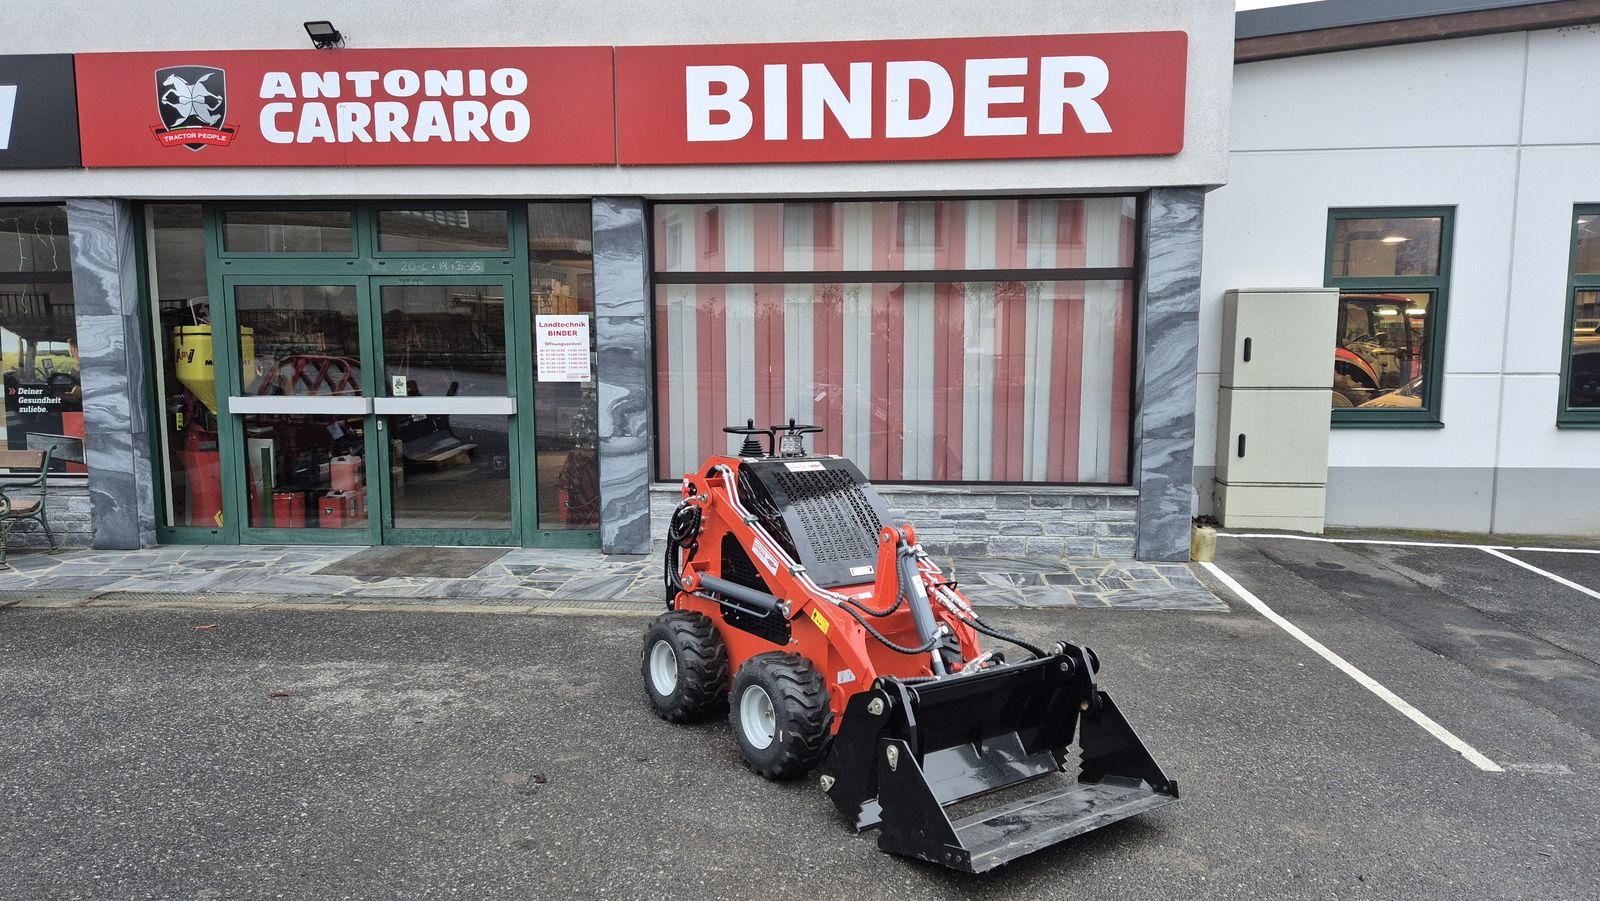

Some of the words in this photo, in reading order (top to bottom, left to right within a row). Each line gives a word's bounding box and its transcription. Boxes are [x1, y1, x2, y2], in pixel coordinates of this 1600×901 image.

[259, 68, 528, 98] ANTONIO
[686, 56, 1113, 141] BINDER
[259, 99, 531, 144] CARRARO
[163, 133, 197, 142] TRACTOR
[198, 133, 227, 142] PEOPLE
[17, 387, 44, 395] Deiner
[18, 396, 62, 404] Gesundheit
[18, 405, 49, 413] zuliebe.
